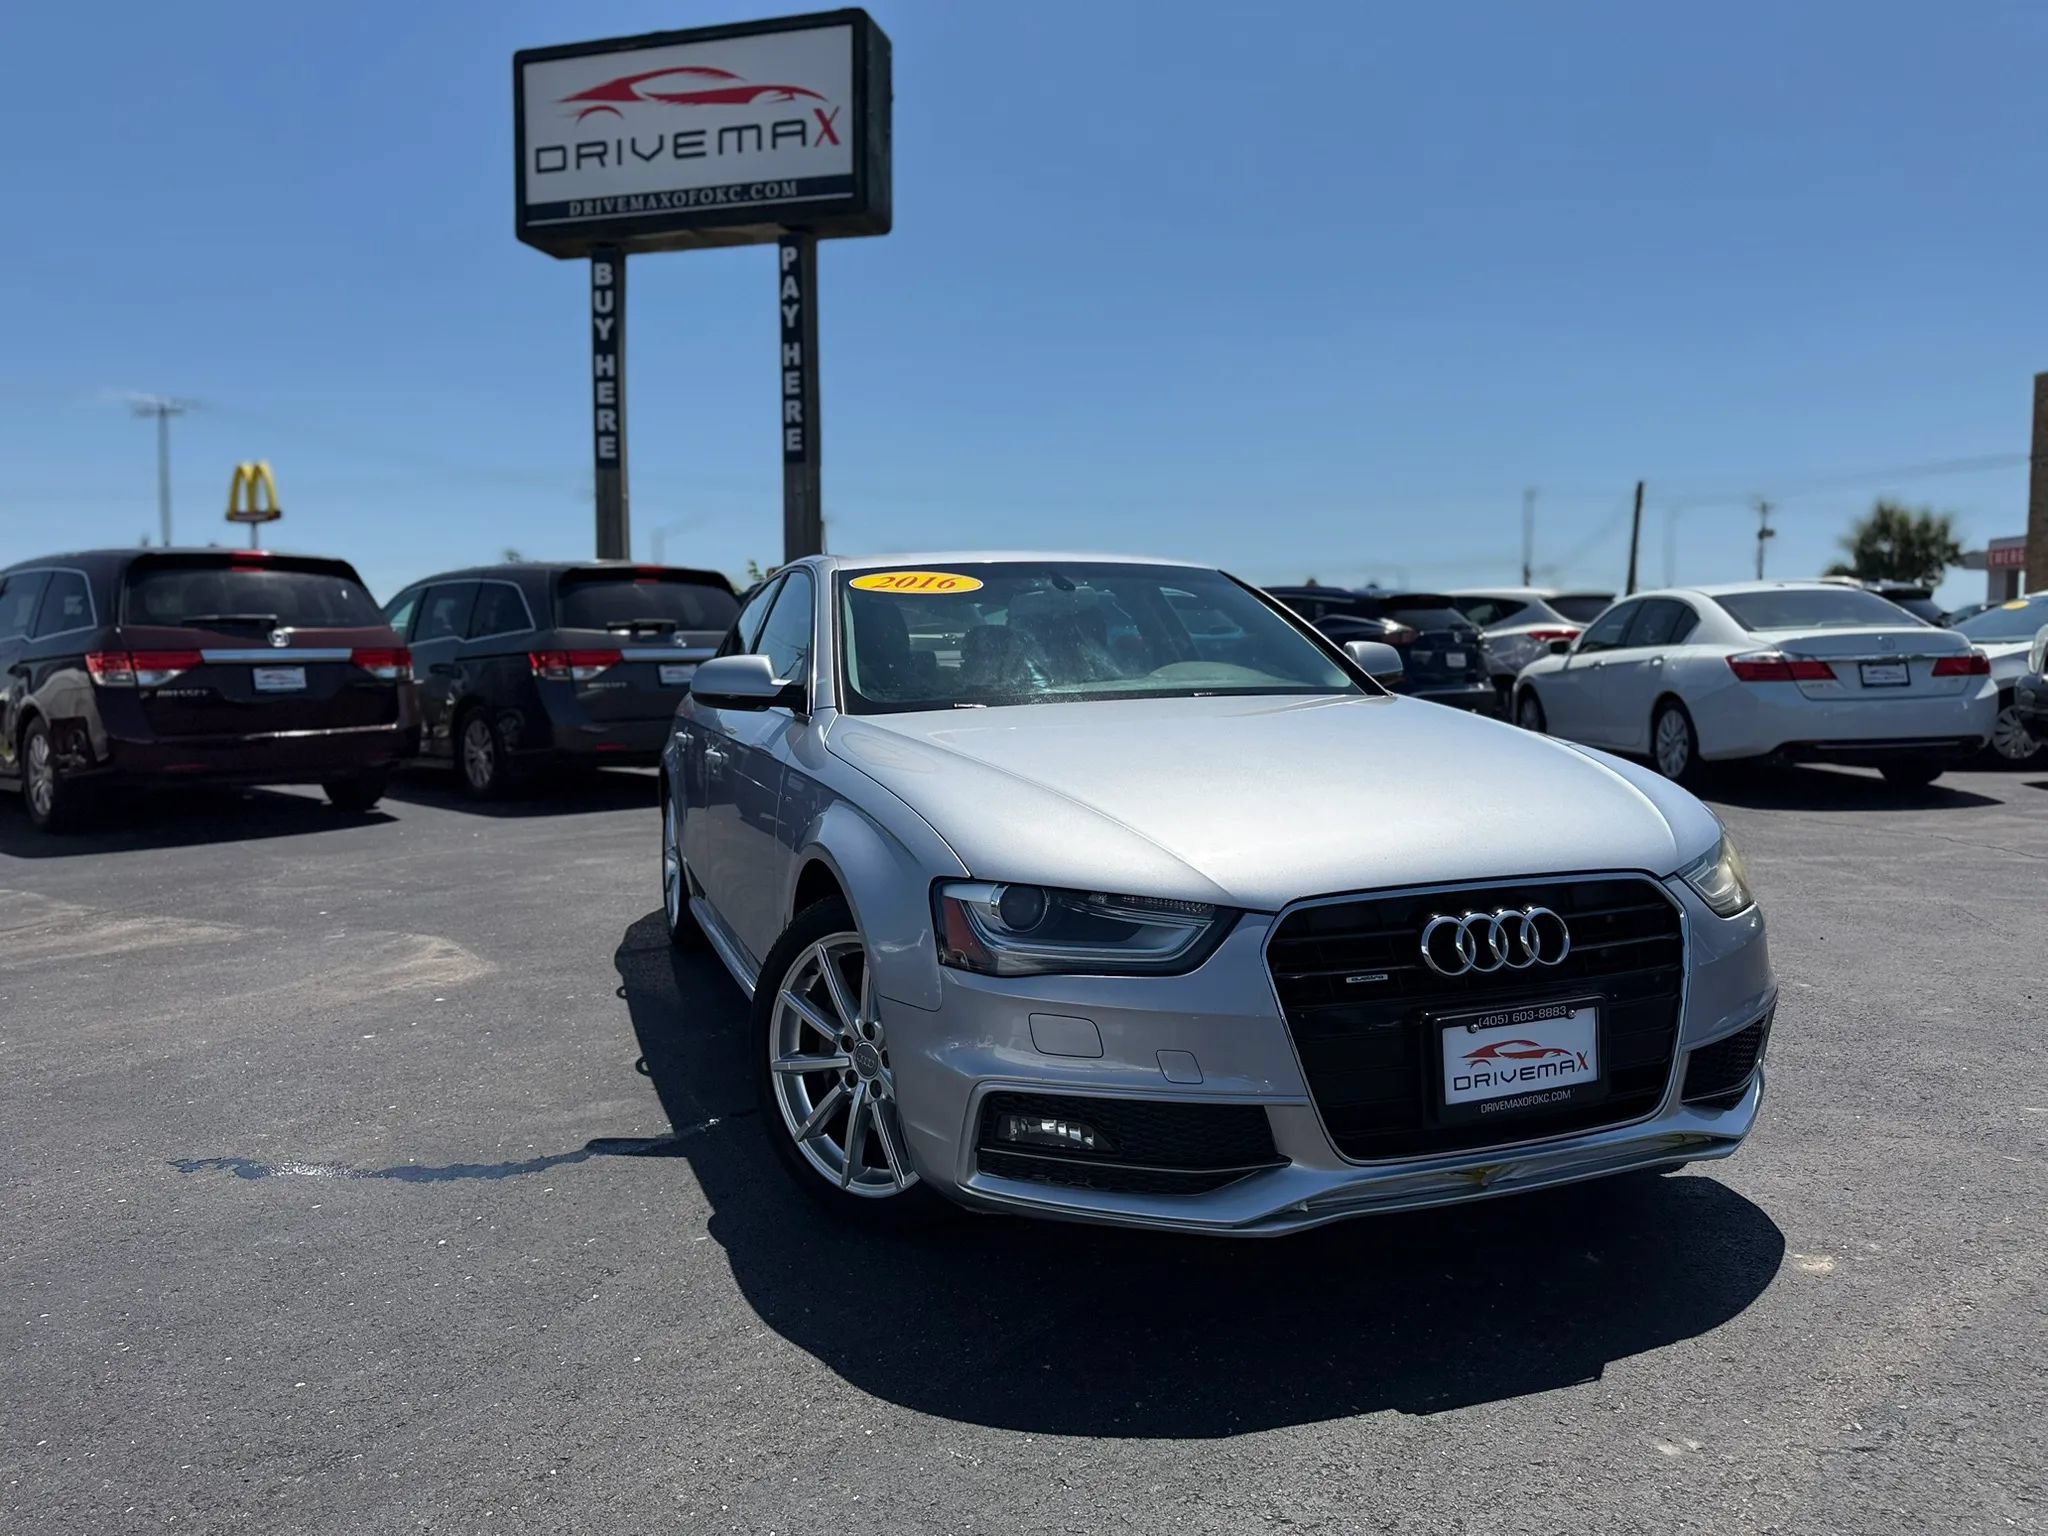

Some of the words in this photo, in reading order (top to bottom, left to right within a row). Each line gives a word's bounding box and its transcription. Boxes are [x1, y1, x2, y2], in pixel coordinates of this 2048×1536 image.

[534, 105, 841, 174] DRIVEMAX
[569, 182, 799, 217] DRIVEMAXOFOKC.COM
[594, 262, 614, 341] BUY
[781, 246, 800, 328] PAY
[595, 354, 617, 459] HERE
[783, 343, 803, 451] HERE
[871, 575, 962, 589] 2016
[1478, 1014, 1509, 1028] (405)
[1512, 1006, 1567, 1021] 603-8883
[1453, 1050, 1588, 1091] DRIVEMAX
[1480, 1090, 1571, 1114] DRIVEMAXOFOKC.COM
